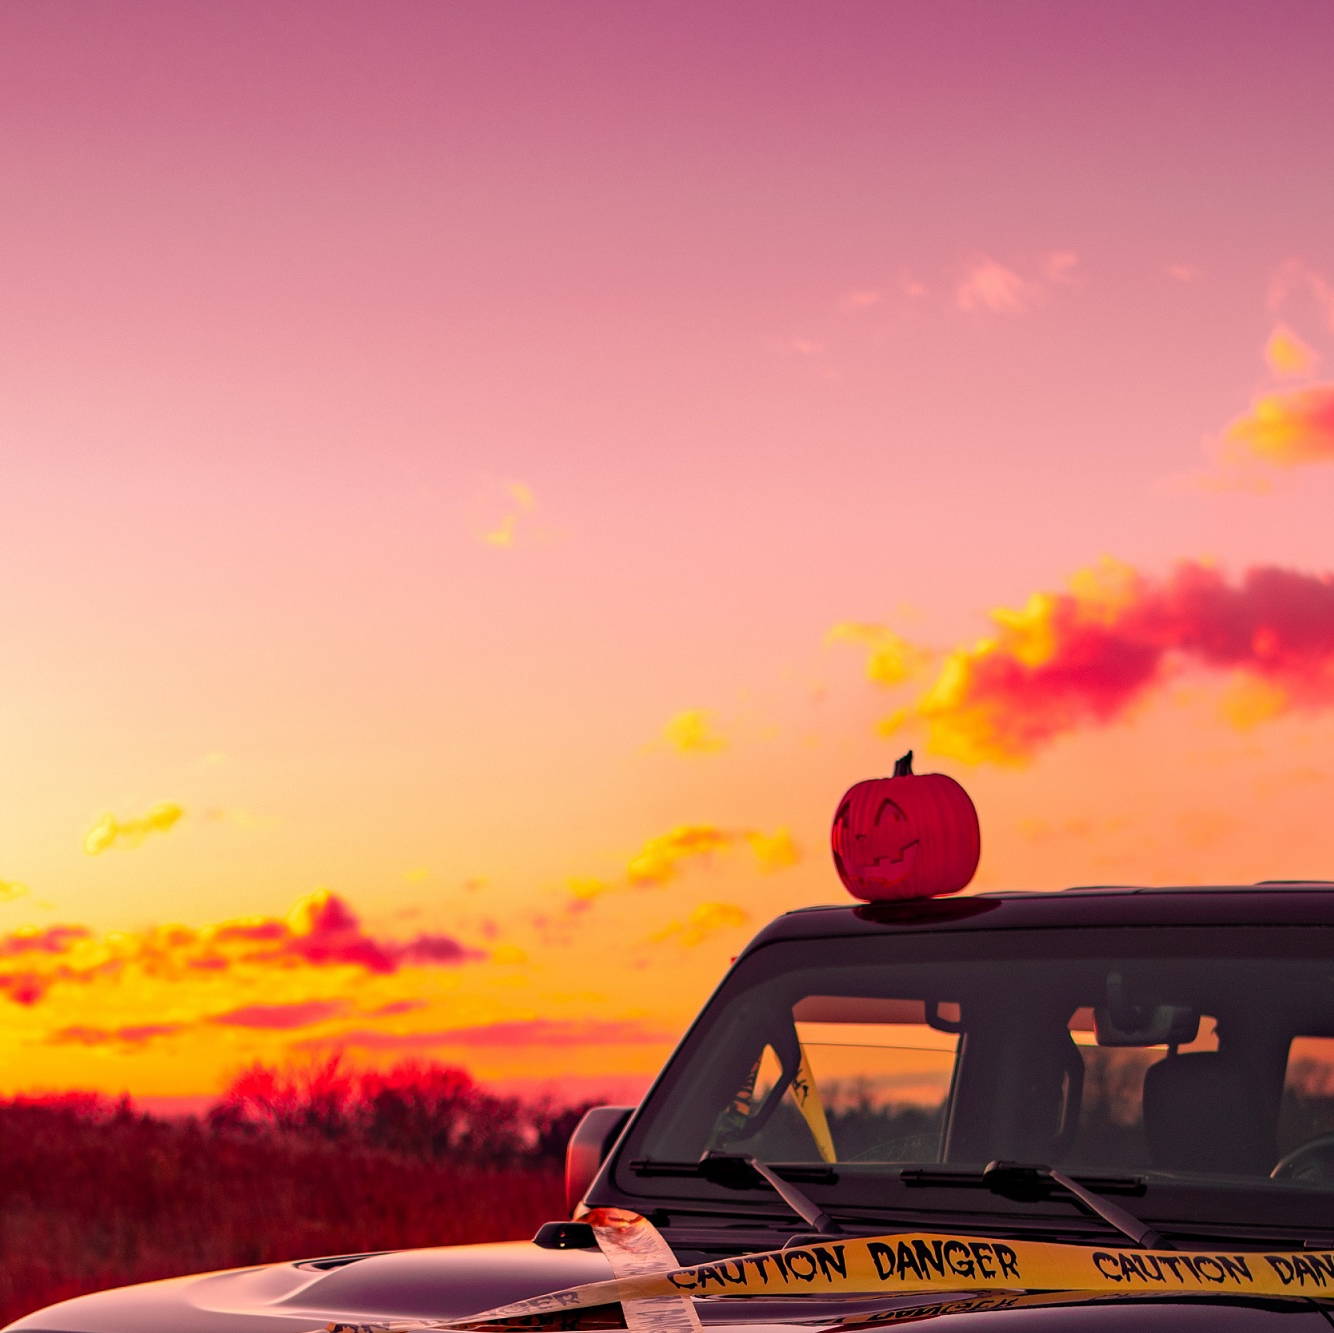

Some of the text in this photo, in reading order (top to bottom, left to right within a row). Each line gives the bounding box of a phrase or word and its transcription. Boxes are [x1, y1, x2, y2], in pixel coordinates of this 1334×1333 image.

[667, 1246, 847, 1289] CAUTION
[867, 1239, 1021, 1280] DANGER
[1092, 1252, 1254, 1285] CAUTION
